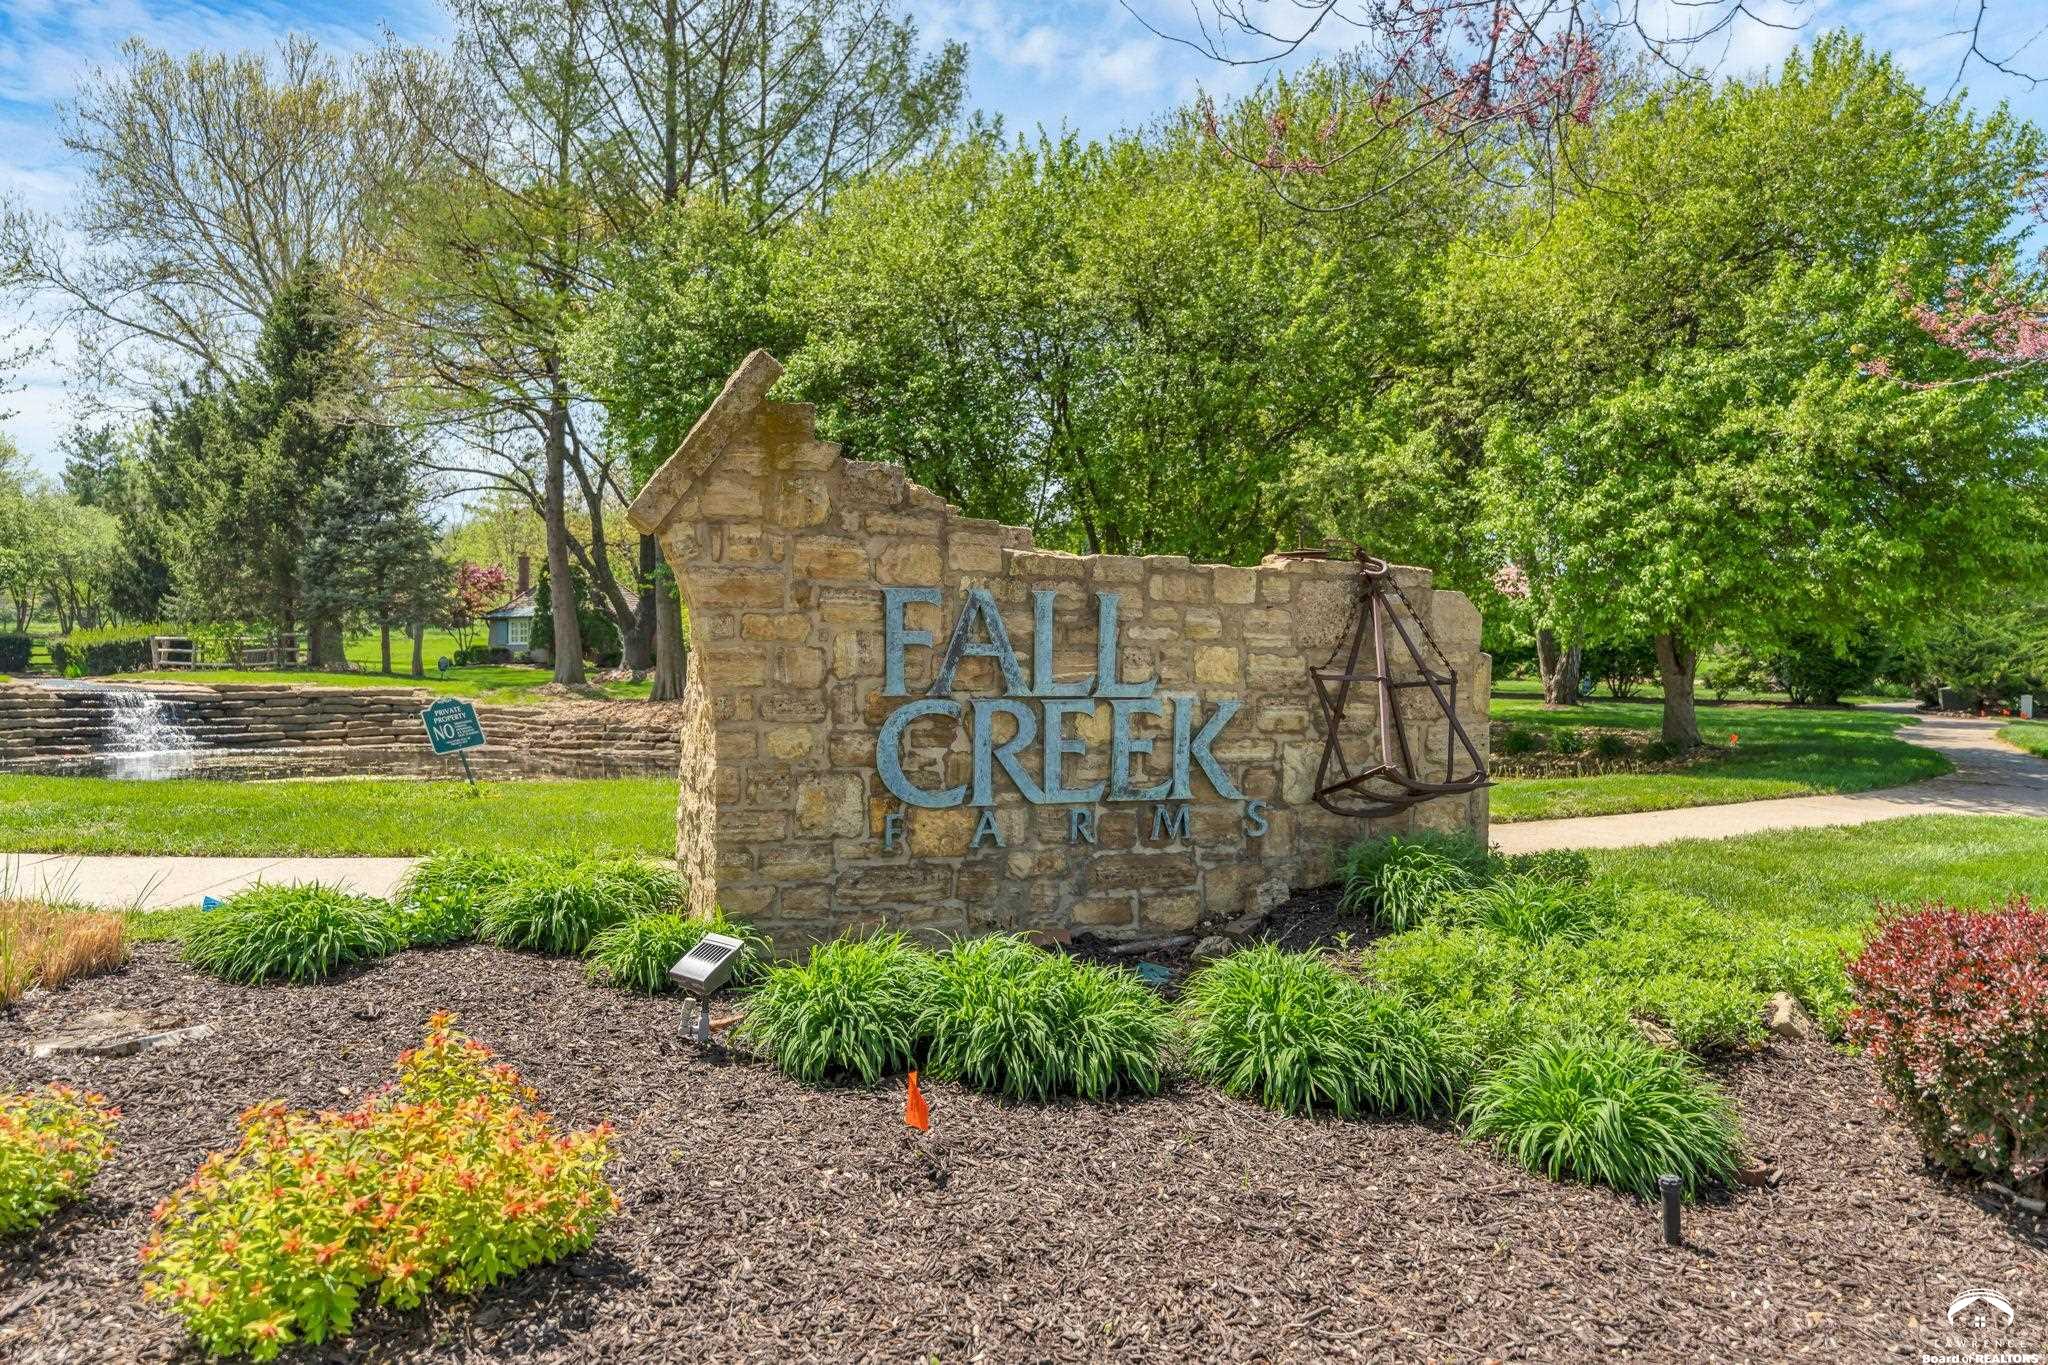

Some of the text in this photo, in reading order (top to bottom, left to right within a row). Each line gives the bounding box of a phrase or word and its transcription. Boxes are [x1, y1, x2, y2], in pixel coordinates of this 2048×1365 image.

[881, 587, 1159, 698] FALL
[434, 706, 461, 717] PRIVATE
[434, 712, 465, 724] PROPERTY
[432, 723, 454, 741] NO
[876, 695, 1248, 808] CREEK
[884, 799, 1270, 852] FARMS
